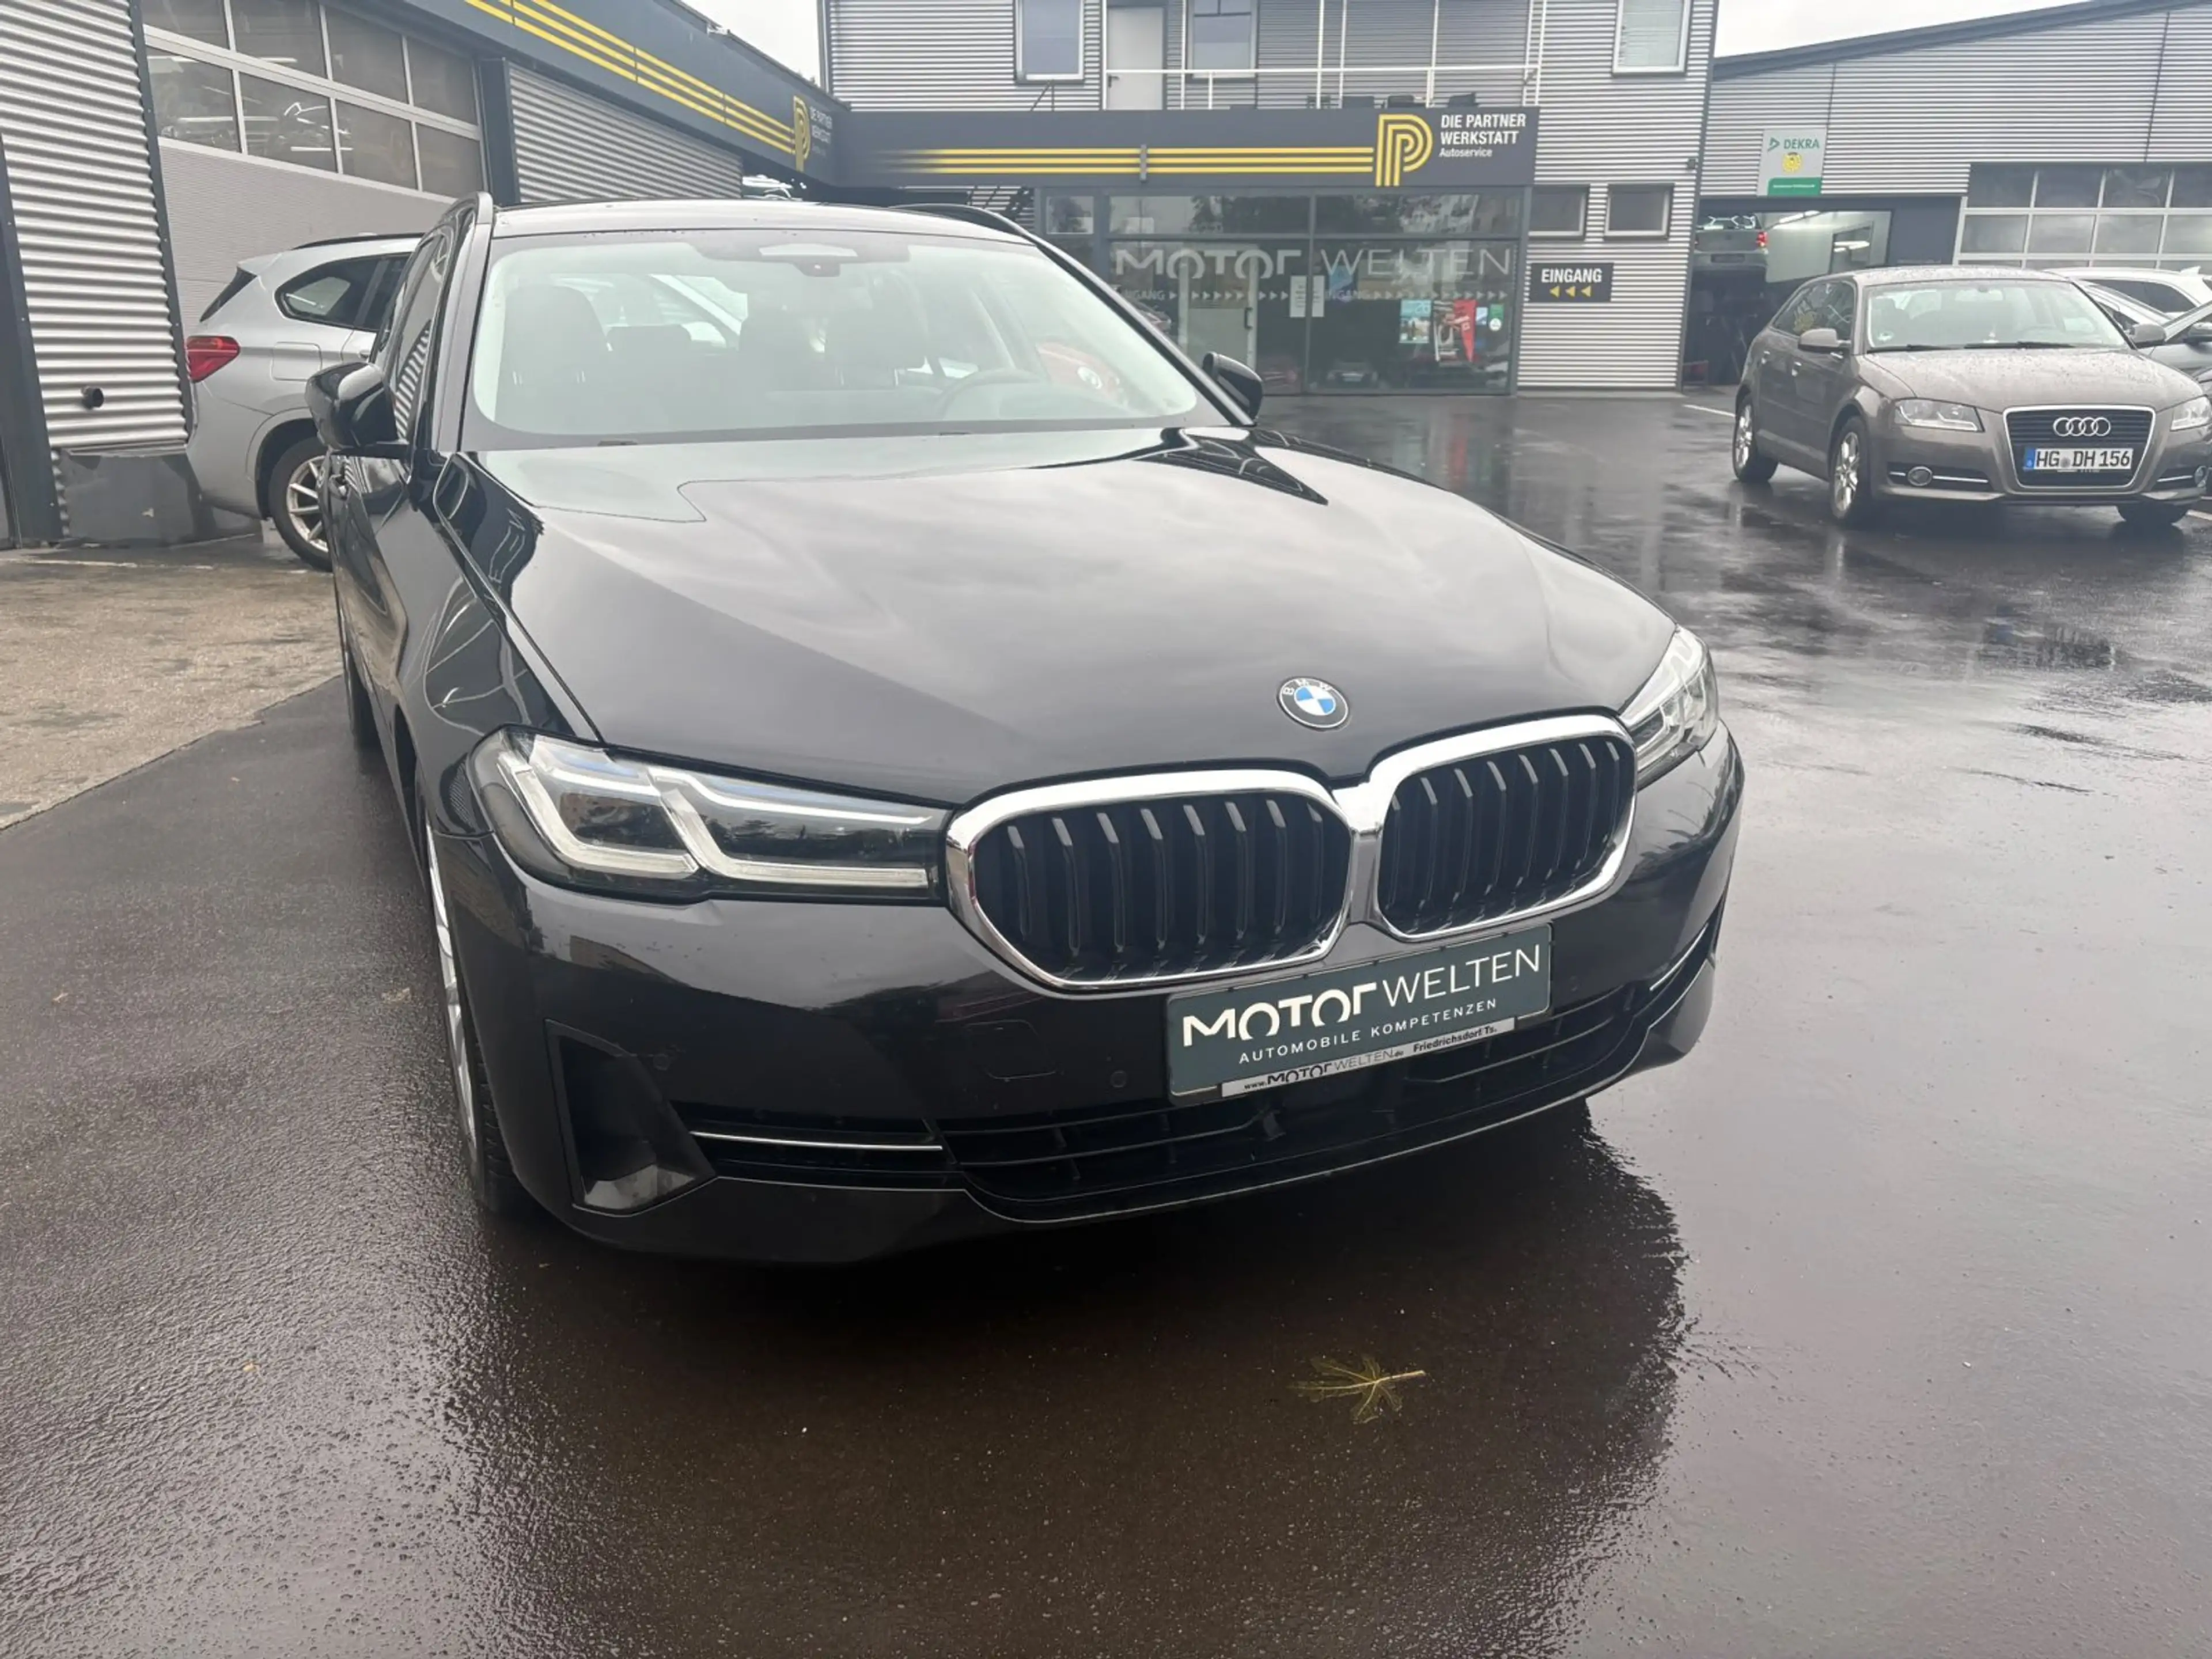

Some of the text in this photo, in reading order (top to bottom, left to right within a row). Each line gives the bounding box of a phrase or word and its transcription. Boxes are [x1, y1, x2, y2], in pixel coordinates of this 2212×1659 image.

[1441, 113, 1527, 128] DIE PARTNER
[1440, 130, 1519, 145] WERKSTATT
[1783, 138, 1820, 149] DEKRA
[1439, 147, 1493, 157] Autoservice
[1541, 268, 1602, 283] EINGANG
[2036, 450, 2130, 467] HG DH 156
[1382, 944, 1540, 1007] WELTEN
[1238, 998, 1497, 1064] AUTOMOBILE KOMPETENZEN
[1412, 1028, 1482, 1053] Friedrichsdorf
[1484, 1025, 1498, 1036] Ts.
